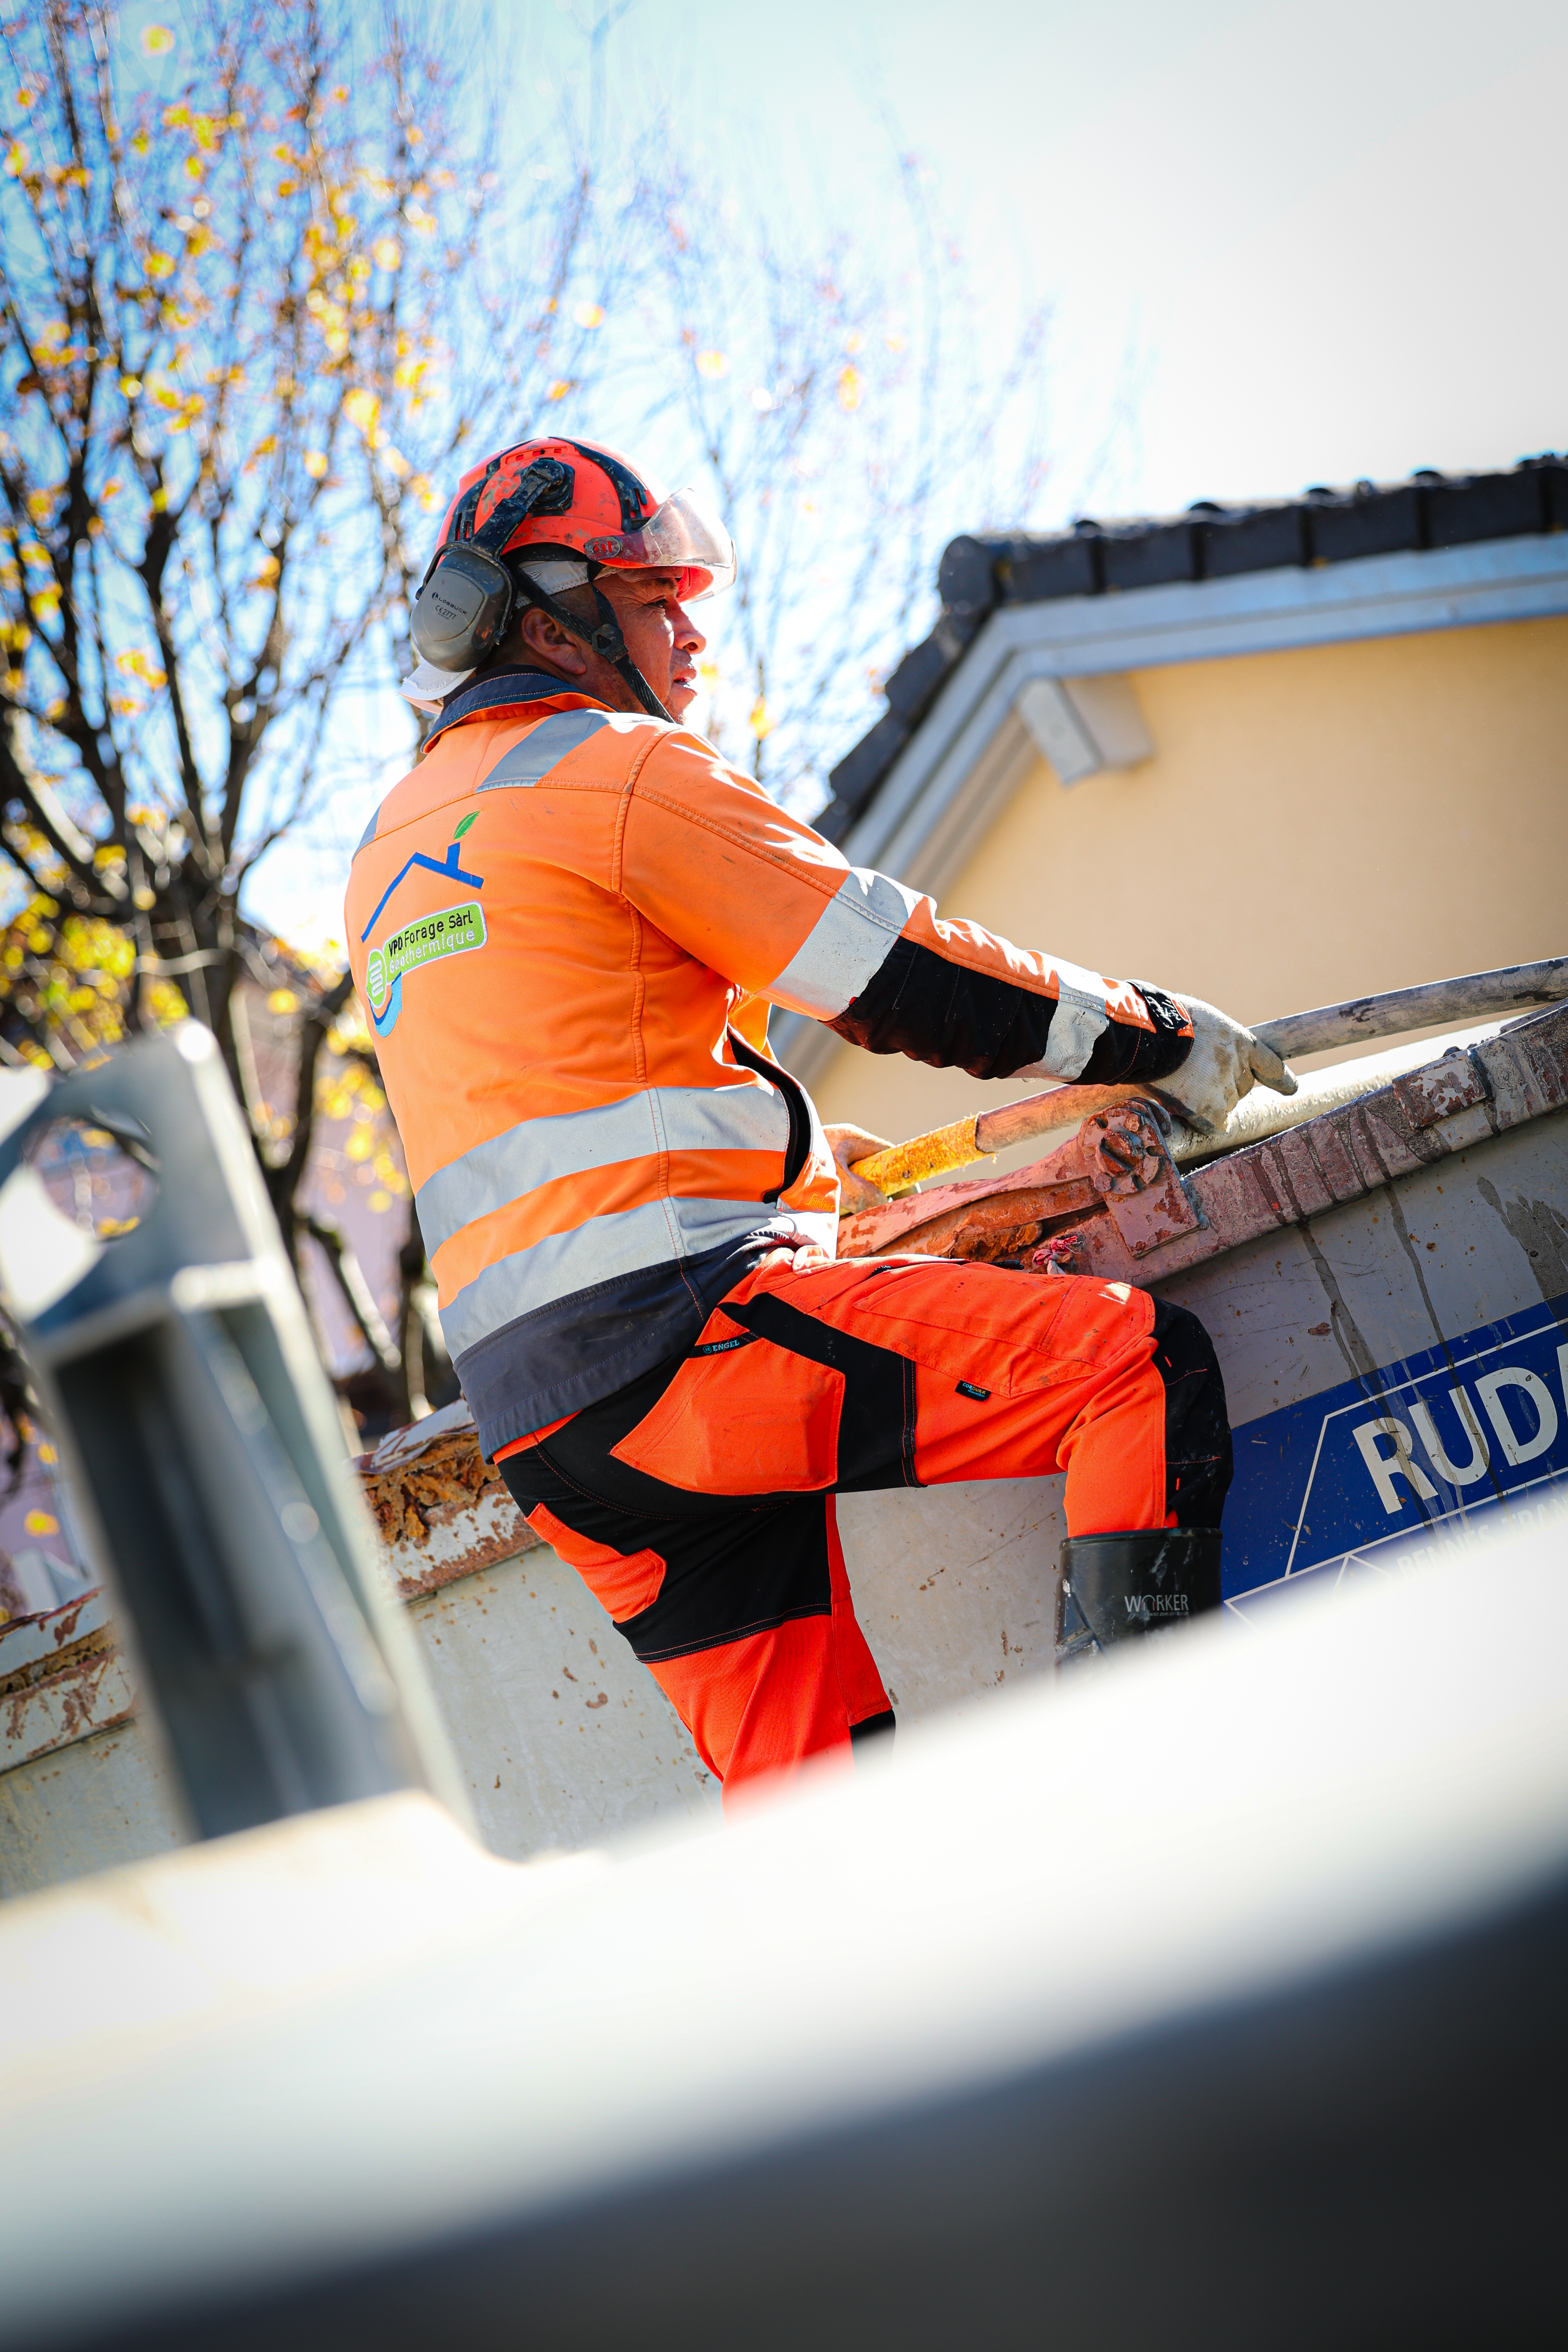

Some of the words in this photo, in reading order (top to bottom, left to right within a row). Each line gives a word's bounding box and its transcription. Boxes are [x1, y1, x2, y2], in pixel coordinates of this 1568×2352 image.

[388, 936, 403, 957] VPD
[405, 921, 444, 948] Forage
[449, 910, 473, 929] Sàrl
[389, 929, 475, 974] Géothermique
[712, 1339, 740, 1352] ENGEL
[962, 1383, 985, 1394] CORDURA
[1352, 1343, 1568, 1515] RUD
[1124, 1594, 1189, 1612] WORKER
